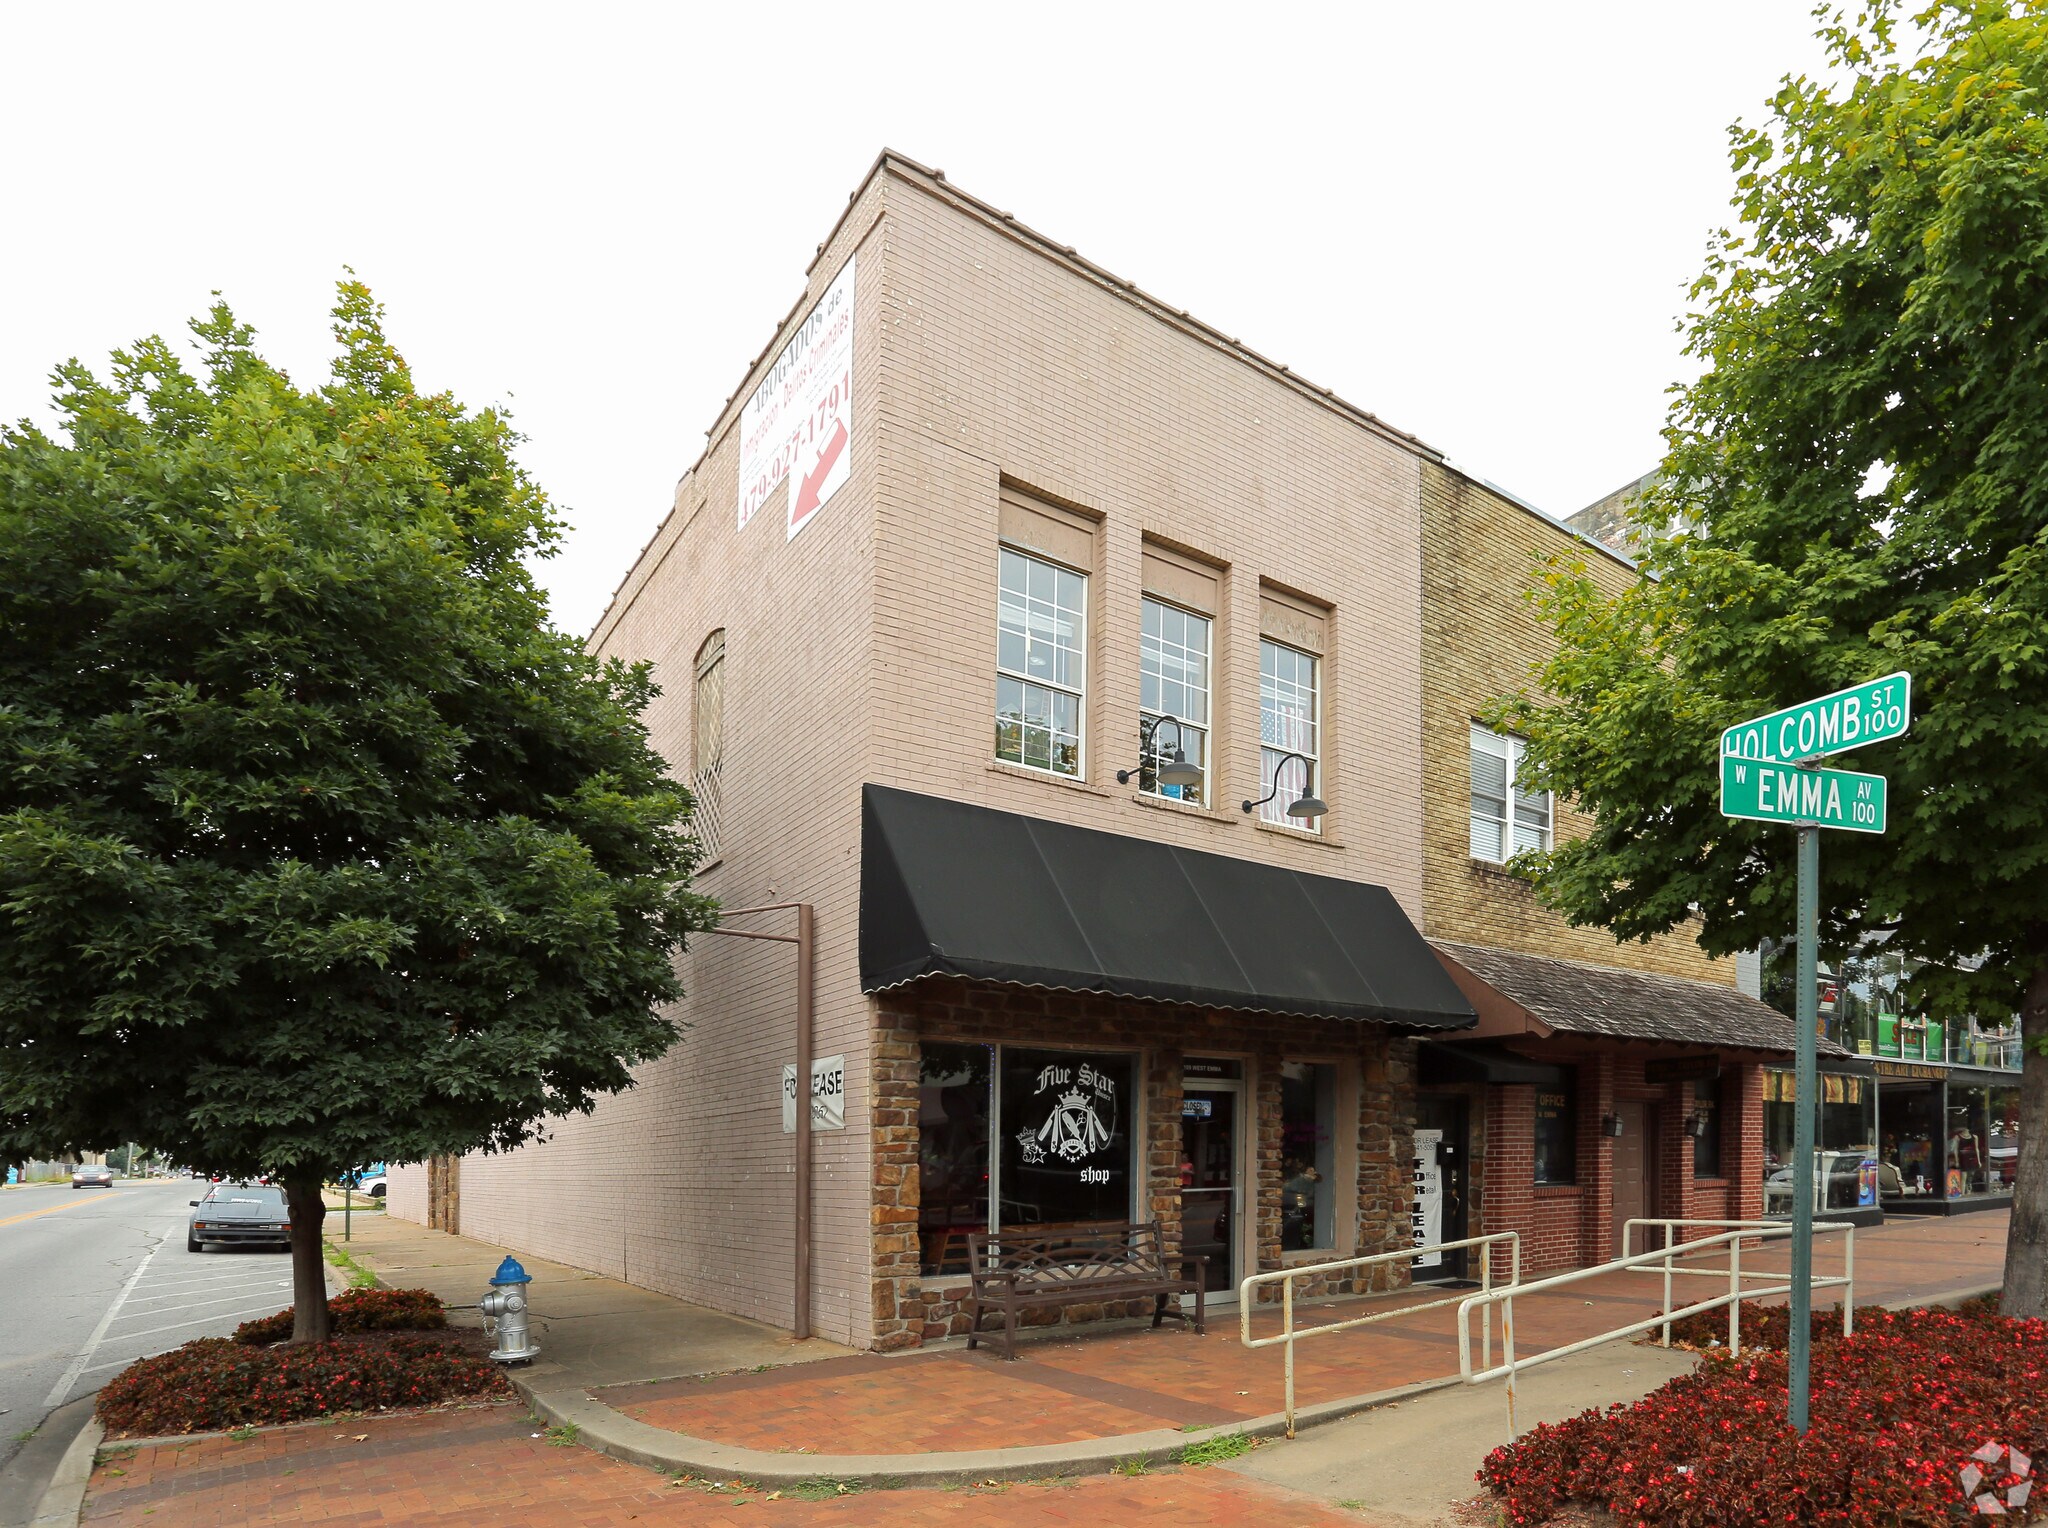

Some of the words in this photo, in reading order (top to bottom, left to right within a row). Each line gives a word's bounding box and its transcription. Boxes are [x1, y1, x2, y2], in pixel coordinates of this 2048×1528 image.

[754, 301, 823, 413] ABOGADOS
[827, 287, 842, 317] de
[808, 307, 849, 374] Criminales
[741, 369, 849, 523] 479-927-1791
[1725, 696, 1861, 761] HOLCOMB
[1871, 685, 1894, 708] ST
[1864, 706, 1901, 736] 100
[1735, 764, 1747, 785] W
[1758, 768, 1843, 820] EMMA
[1857, 781, 1872, 800] AV
[1852, 802, 1876, 824] 100
[1033, 1064, 1071, 1095] Five
[1077, 1062, 1115, 1094] Star
[1881, 1061, 1894, 1075] THE
[1895, 1063, 1908, 1076] ART
[784, 1077, 797, 1099] FO
[812, 1070, 842, 1096] EASE
[1539, 1094, 1566, 1107] OFFICE
[1080, 1166, 1110, 1184] shop
